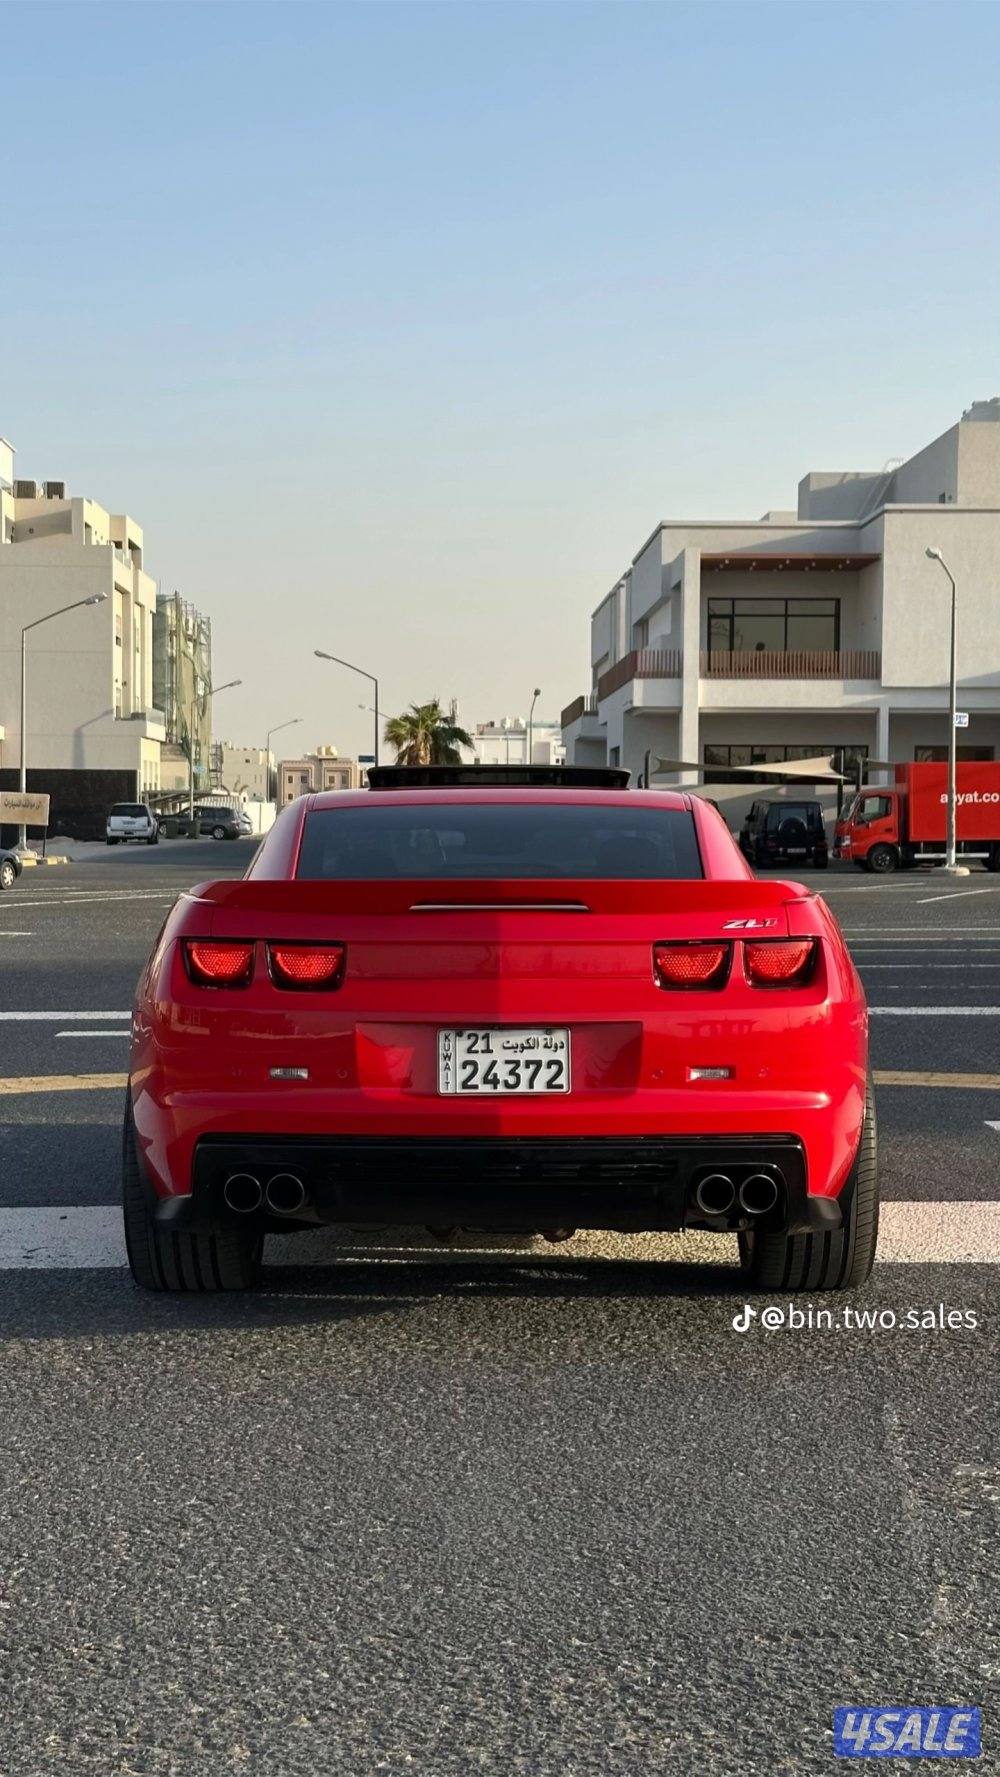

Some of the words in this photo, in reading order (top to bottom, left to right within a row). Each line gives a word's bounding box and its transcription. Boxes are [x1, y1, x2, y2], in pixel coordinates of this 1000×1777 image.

[467, 1033, 493, 1054] 21
[502, 1037, 540, 1053] الكويت
[543, 1036, 565, 1052] دولة
[443, 1033, 451, 1090] KUWAIT
[461, 1059, 564, 1090] 24372
